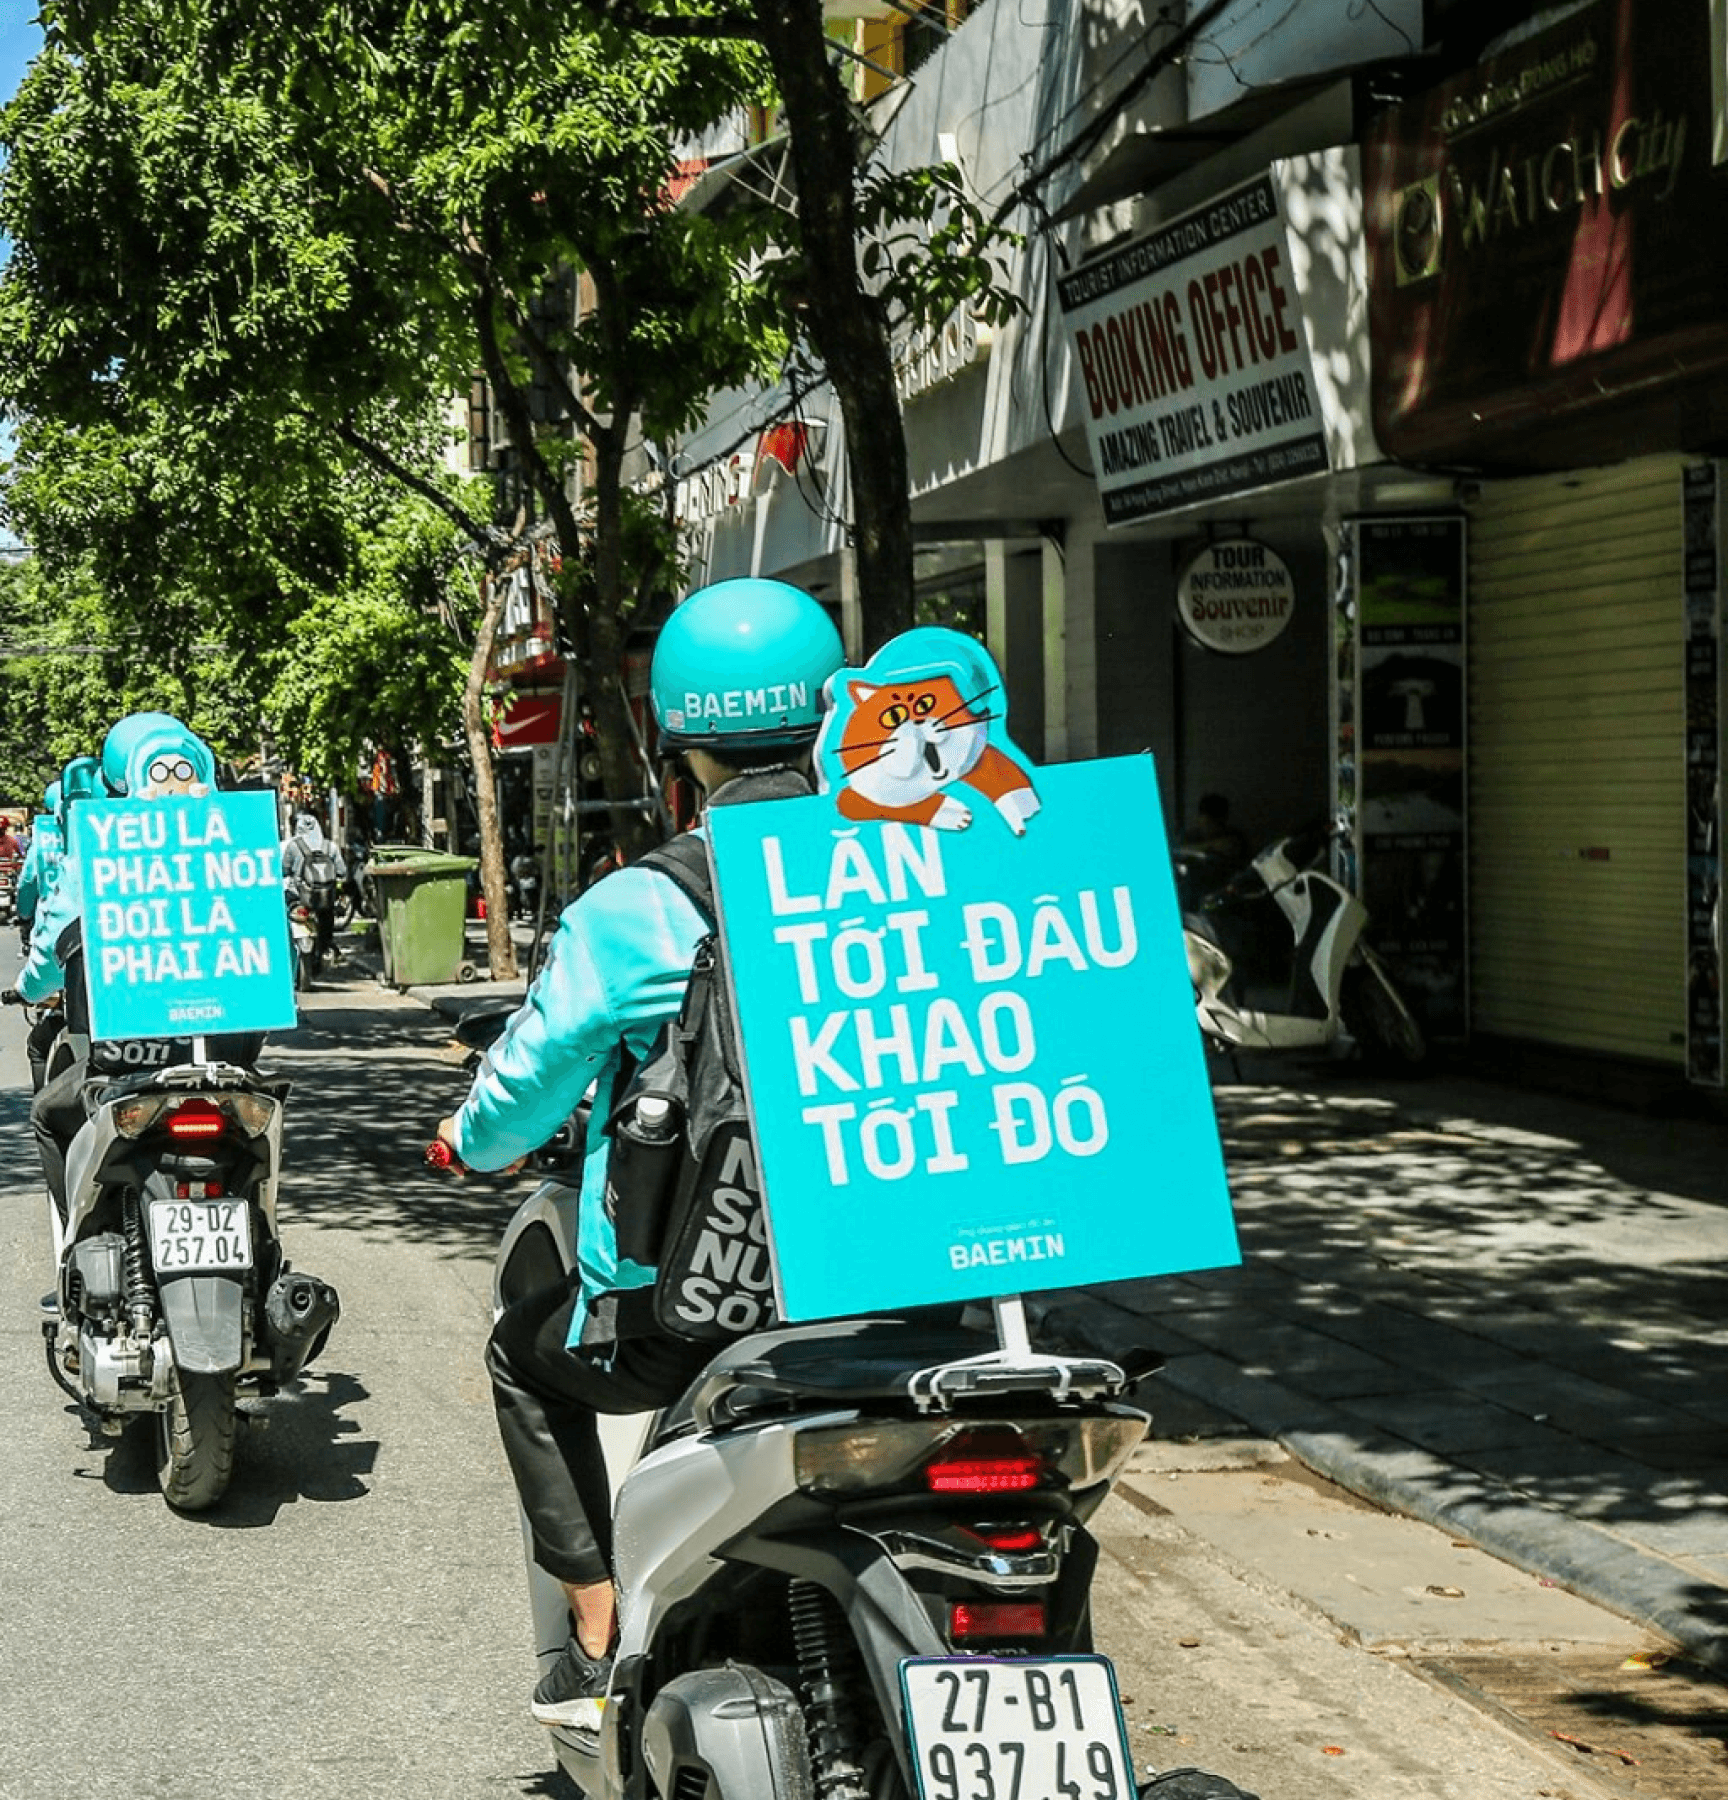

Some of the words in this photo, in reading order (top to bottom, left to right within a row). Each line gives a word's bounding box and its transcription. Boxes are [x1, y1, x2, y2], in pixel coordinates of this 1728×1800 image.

[1609, 108, 1688, 203] City
[1064, 262, 1117, 305] TOURIST
[1122, 221, 1208, 278] INFORMATION
[1209, 186, 1271, 240] CENTER
[1075, 290, 1194, 420] BOOKING
[1187, 245, 1299, 381] OFFICE
[1099, 417, 1161, 477] AMAZING
[1157, 403, 1214, 460] TRAVEL
[1211, 399, 1229, 443] &
[1226, 370, 1313, 438] SOUVENIR
[1190, 570, 1286, 591] INFORMATION
[1212, 545, 1265, 569] TOUR
[1191, 593, 1289, 620] Souvenir
[684, 680, 808, 720] BAEMIN
[87, 810, 167, 850] YÊU
[760, 822, 948, 917] LĂN
[773, 908, 941, 1005] TỚI
[960, 886, 1139, 984] ĐÂU
[789, 990, 1038, 1097] KHAO
[802, 1088, 969, 1187] TỚI
[987, 1072, 1110, 1167] ĐÓ
[165, 1204, 236, 1234] 29-D2
[159, 1236, 245, 1266] 257.04
[948, 1232, 1066, 1270] BAEMIN
[934, 1667, 1085, 1733] 27-B1
[928, 1740, 1118, 1800] 937.49
